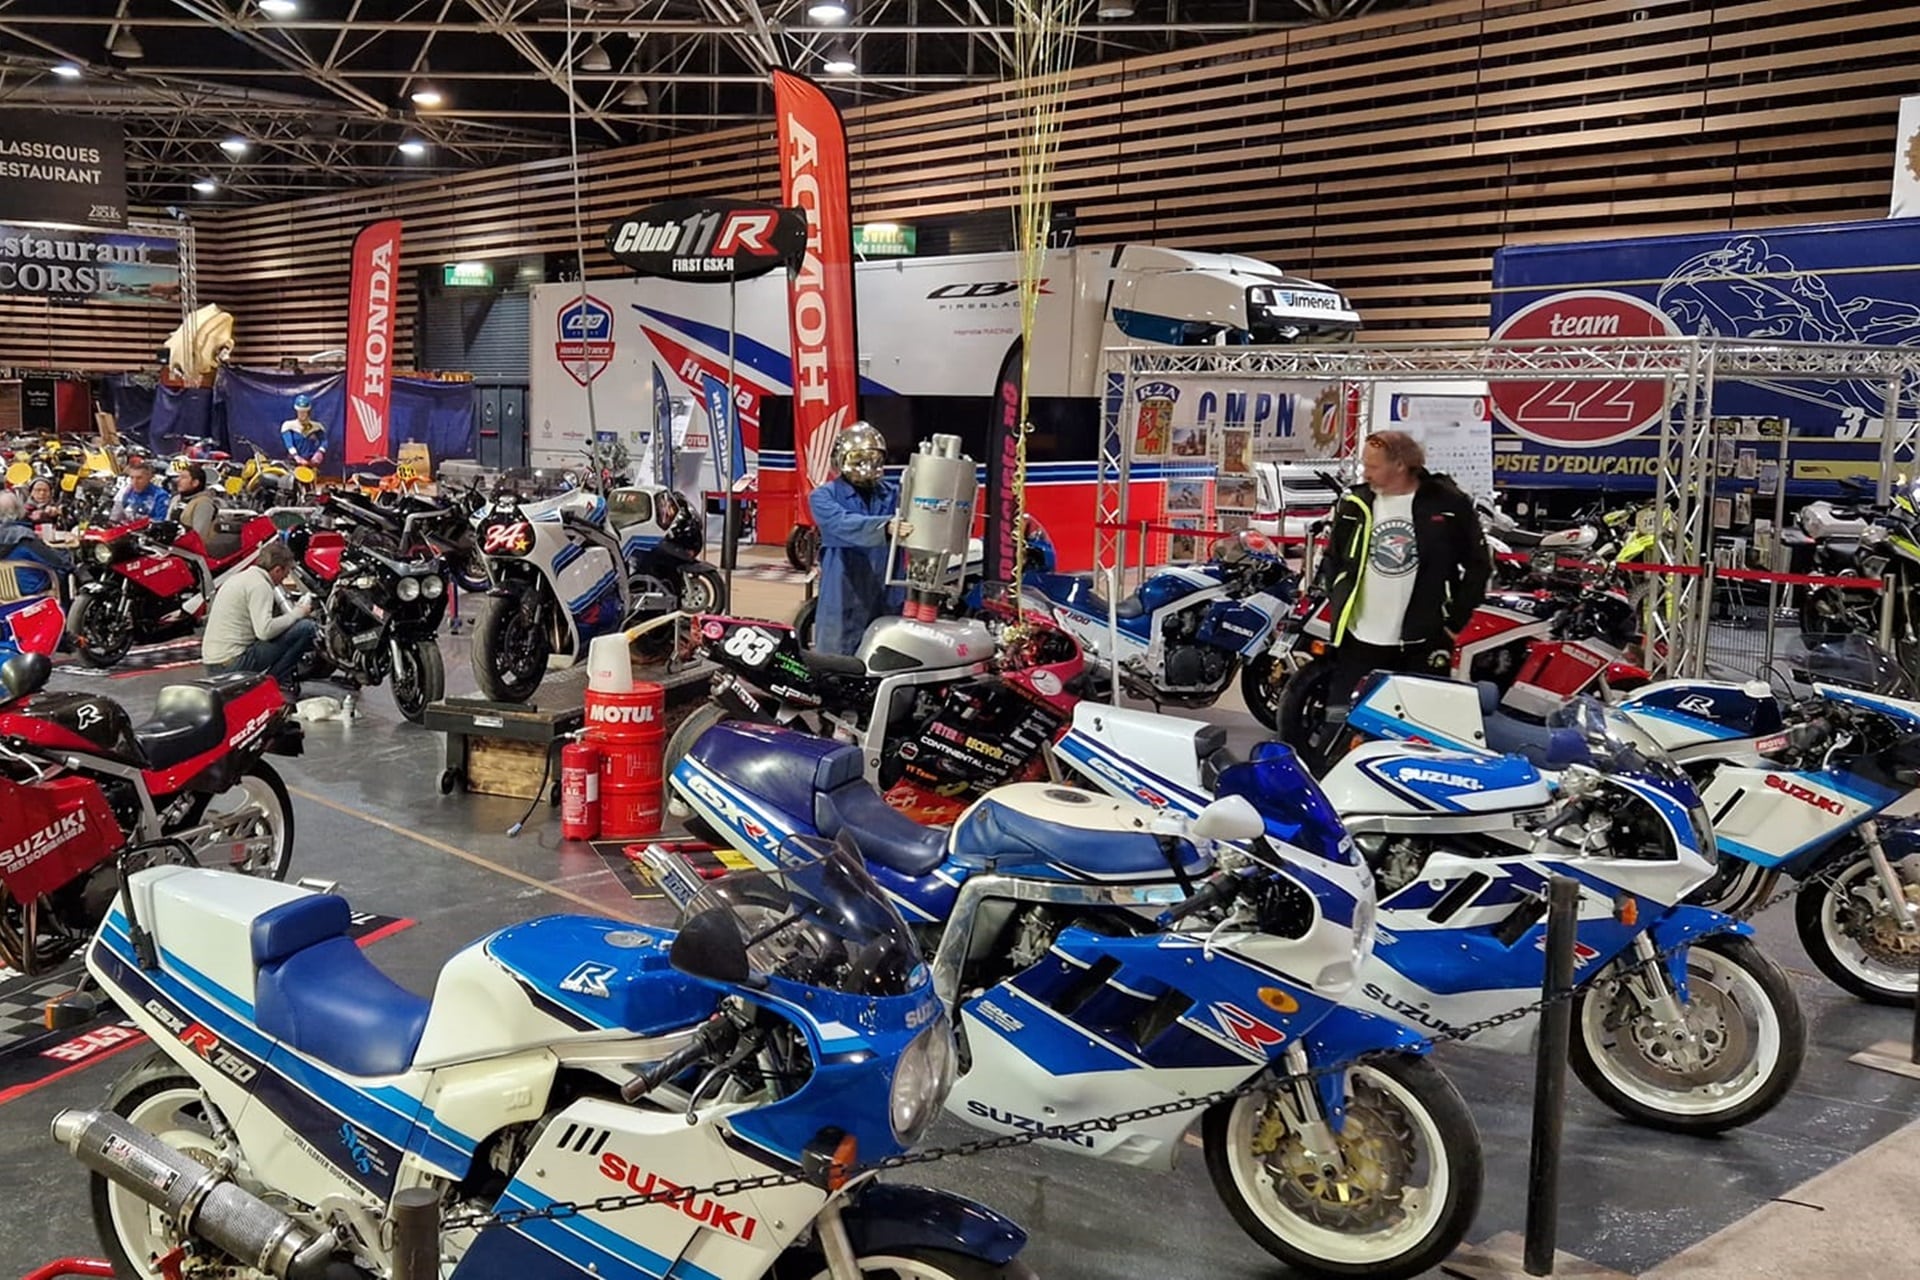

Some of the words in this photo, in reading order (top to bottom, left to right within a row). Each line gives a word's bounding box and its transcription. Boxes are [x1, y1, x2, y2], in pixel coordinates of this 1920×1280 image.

[0, 233, 149, 264] staurant
[672, 258, 700, 273] FIRST
[703, 257, 734, 272] GSX-R
[1288, 292, 1337, 310] Jimenez
[365, 240, 393, 397] HONDA
[1549, 313, 1620, 336] team
[1140, 384, 1176, 400] R2A
[1493, 454, 1540, 473] PISTE
[484, 520, 529, 553] 34
[724, 627, 774, 666] 83
[590, 704, 654, 724] MOTUL
[1396, 767, 1485, 791] SUZUKI
[1763, 774, 1845, 817] SUZUKI
[0, 808, 86, 868] SUZUKI
[599, 1151, 757, 1241] SUZUKI
